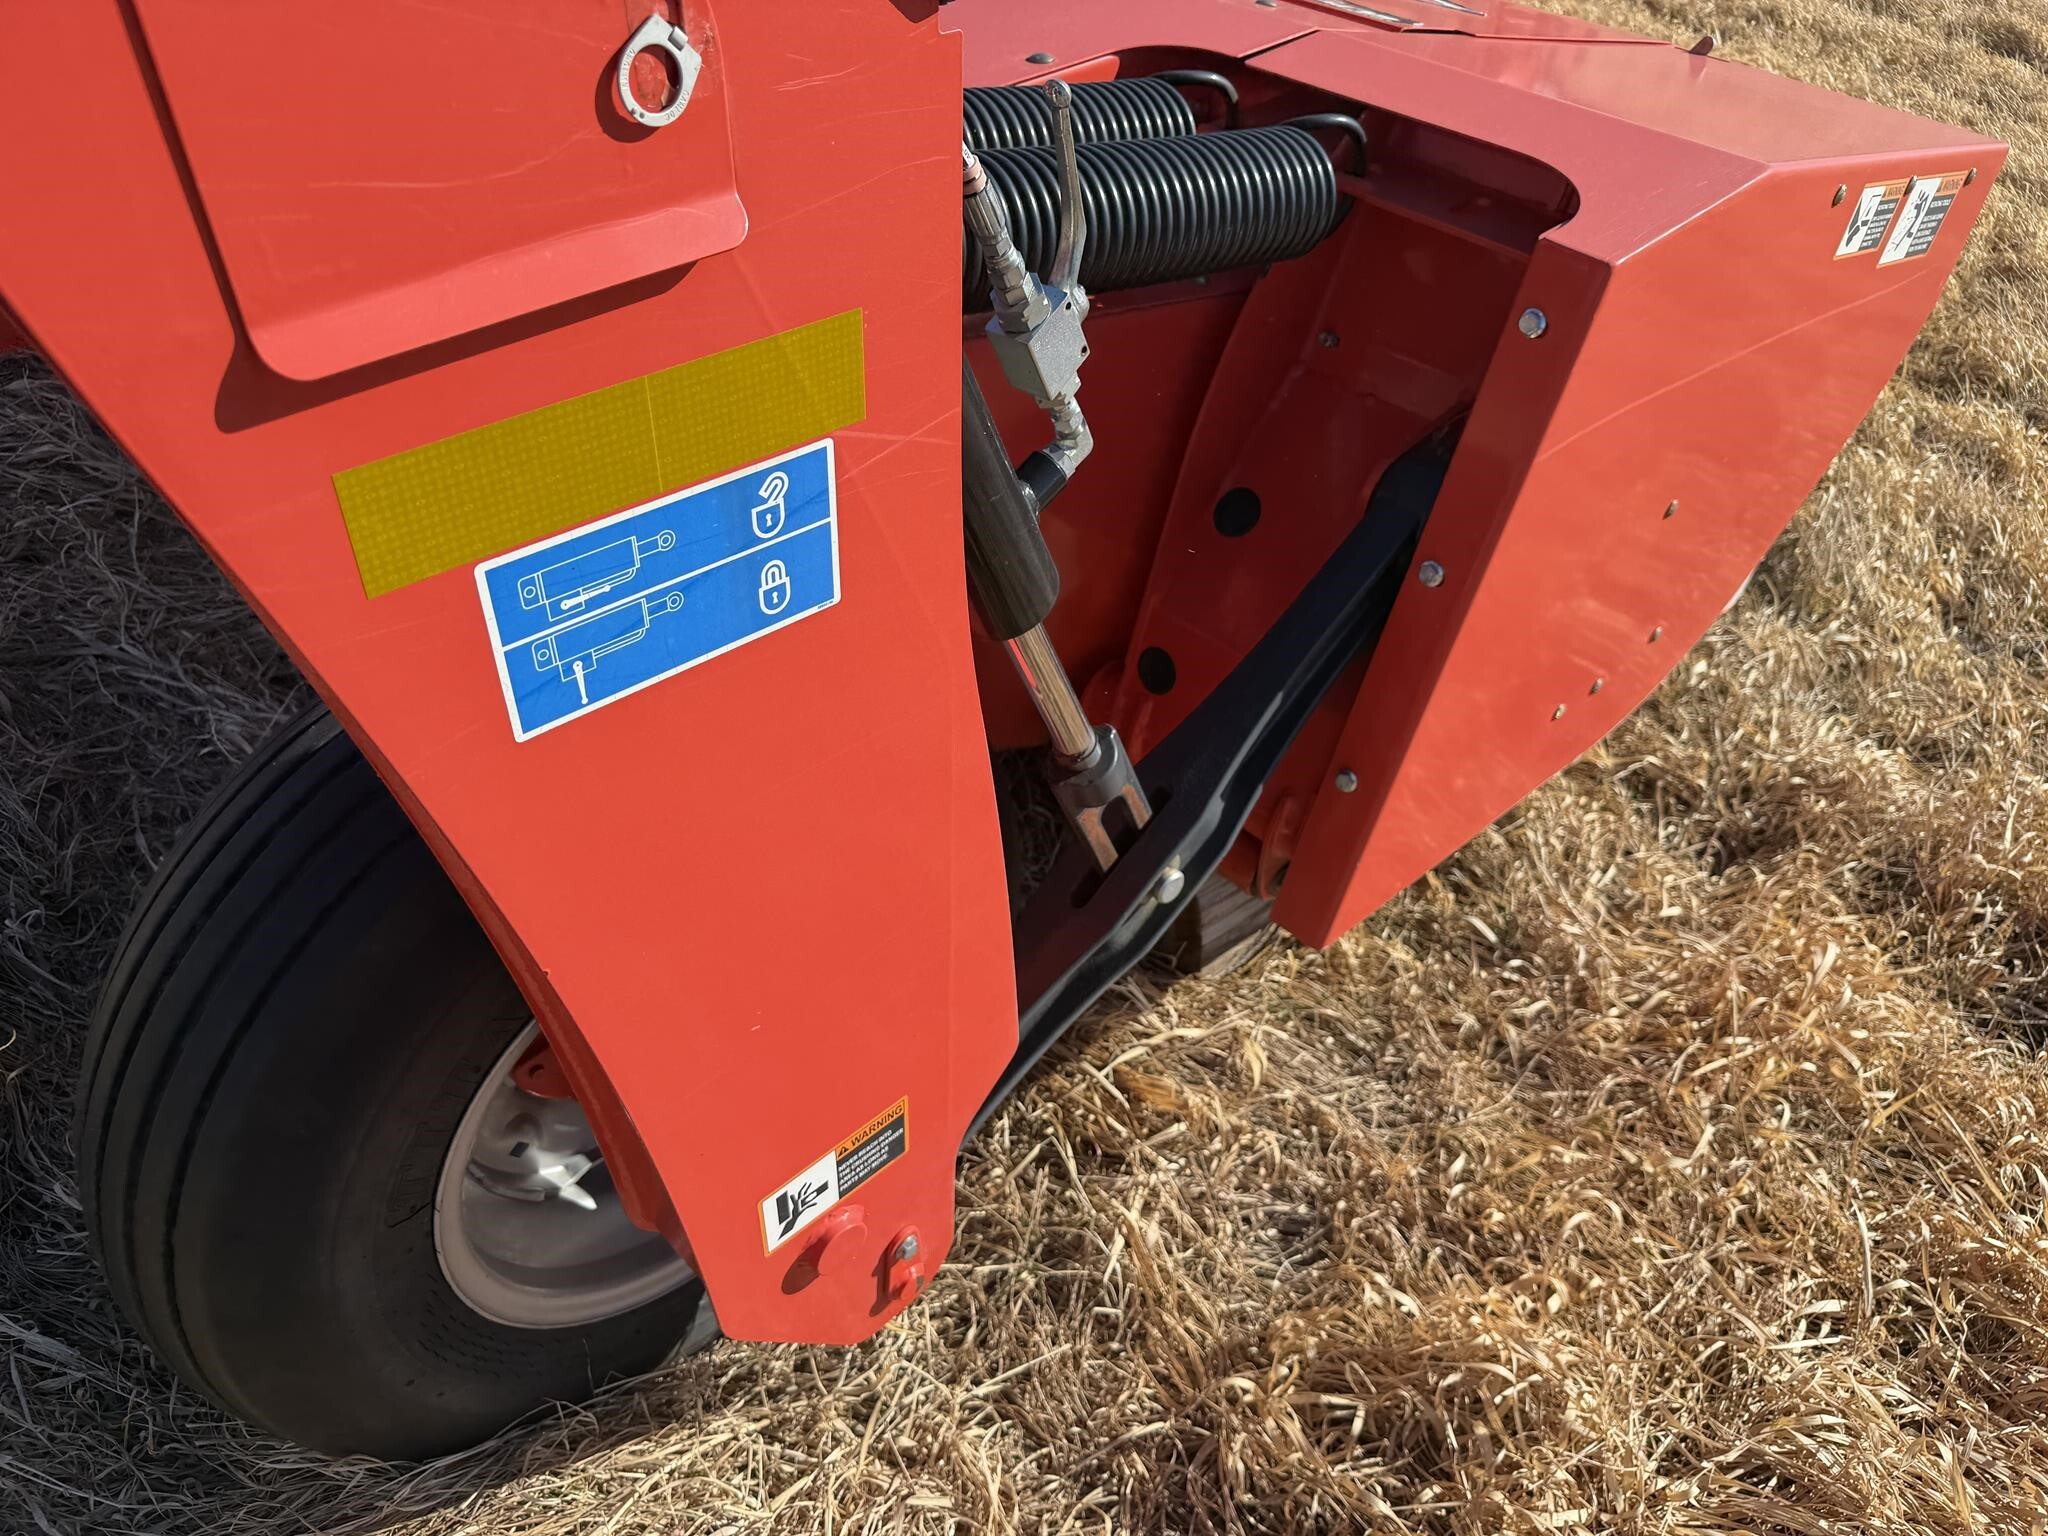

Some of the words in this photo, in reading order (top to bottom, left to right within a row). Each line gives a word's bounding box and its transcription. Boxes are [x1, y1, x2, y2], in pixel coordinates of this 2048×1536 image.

[851, 1104, 902, 1146] WARNING
[838, 1155, 858, 1172] NEVER
[858, 1139, 878, 1157] REACH
[879, 1129, 892, 1142] INTO
[839, 1166, 850, 1178] THE
[851, 1145, 880, 1169] CRUSHING
[880, 1128, 903, 1147] DANGER
[839, 1170, 855, 1185] AREA
[856, 1163, 864, 1173] AS
[864, 1152, 880, 1167] LONG
[881, 1145, 889, 1155] AS
[839, 1175, 858, 1192] PARTS
[859, 1165, 870, 1177] MAY
